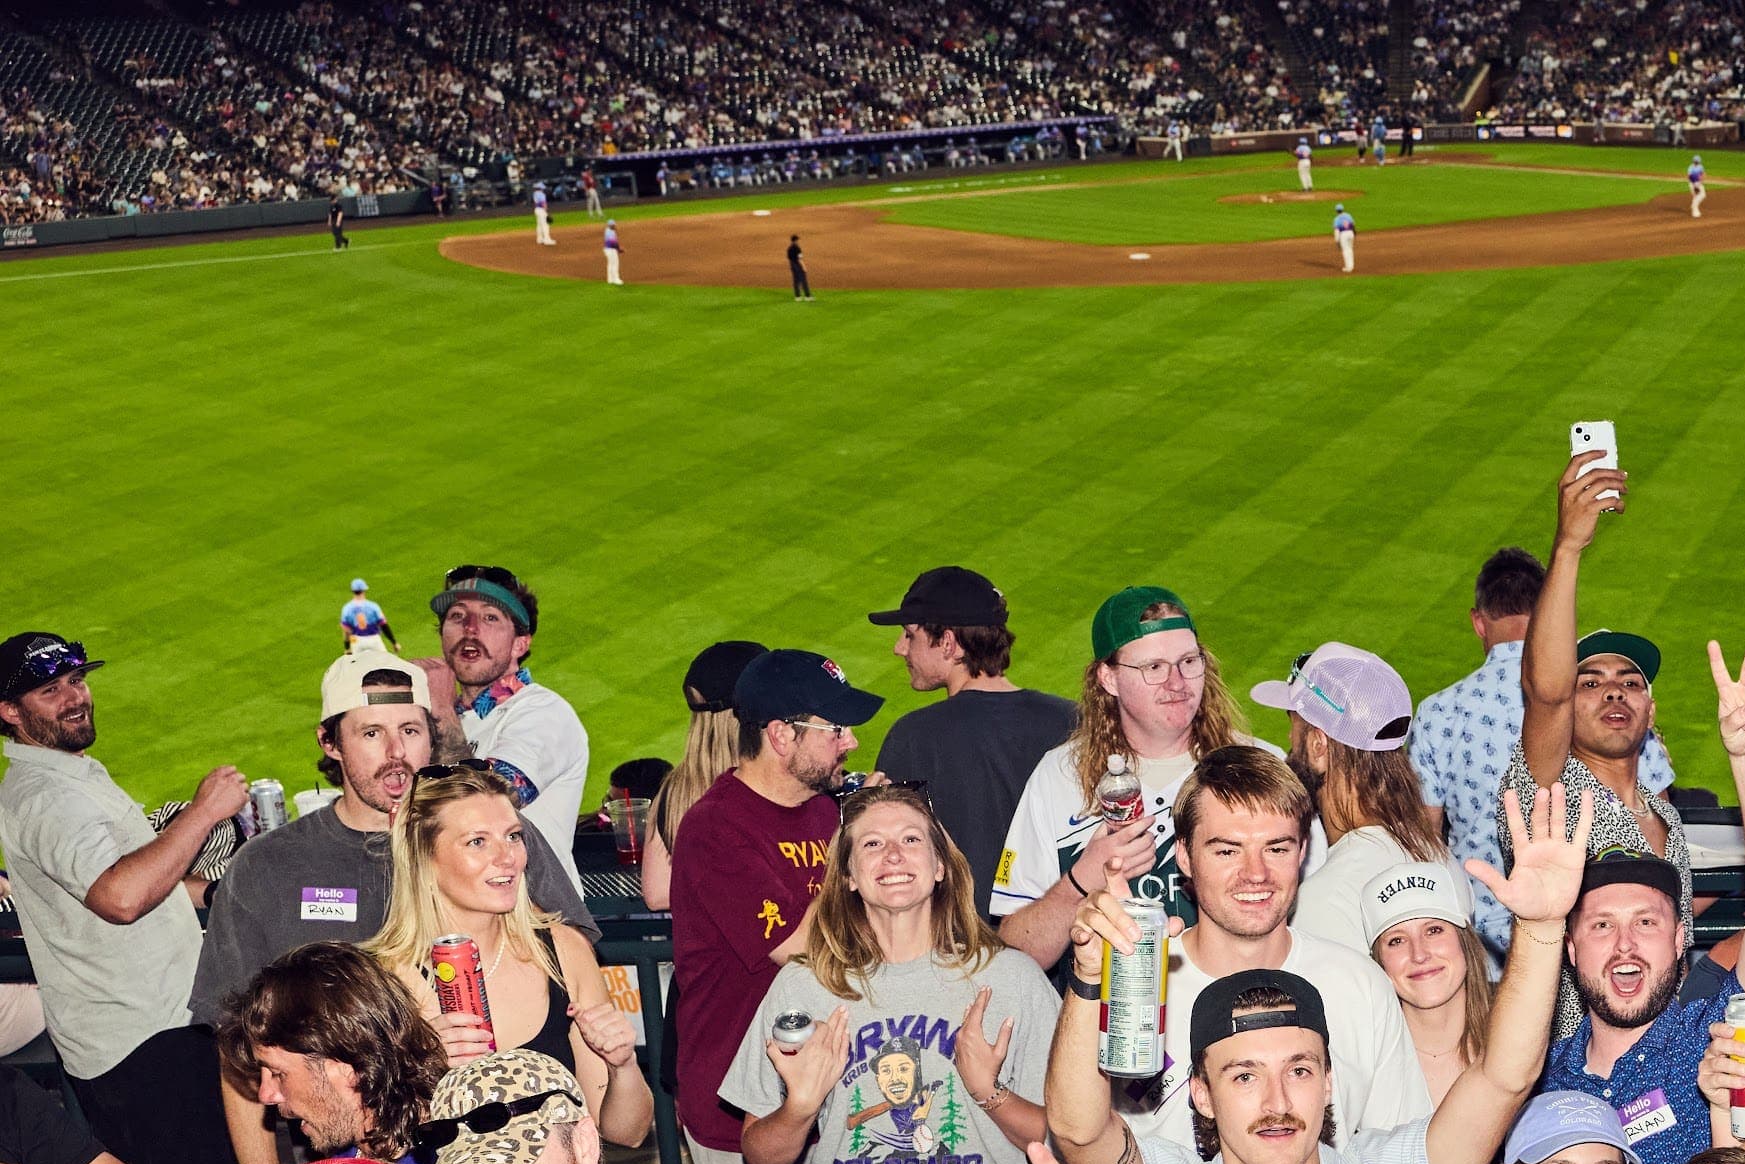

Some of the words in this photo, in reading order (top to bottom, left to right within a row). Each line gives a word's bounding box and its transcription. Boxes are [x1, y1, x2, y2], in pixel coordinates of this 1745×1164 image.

[315, 888, 344, 898] Hello
[1378, 876, 1436, 903] DENVER
[308, 904, 344, 915] RYAN
[1623, 1098, 1651, 1118] Hello
[1624, 1111, 1665, 1141] RYAN
